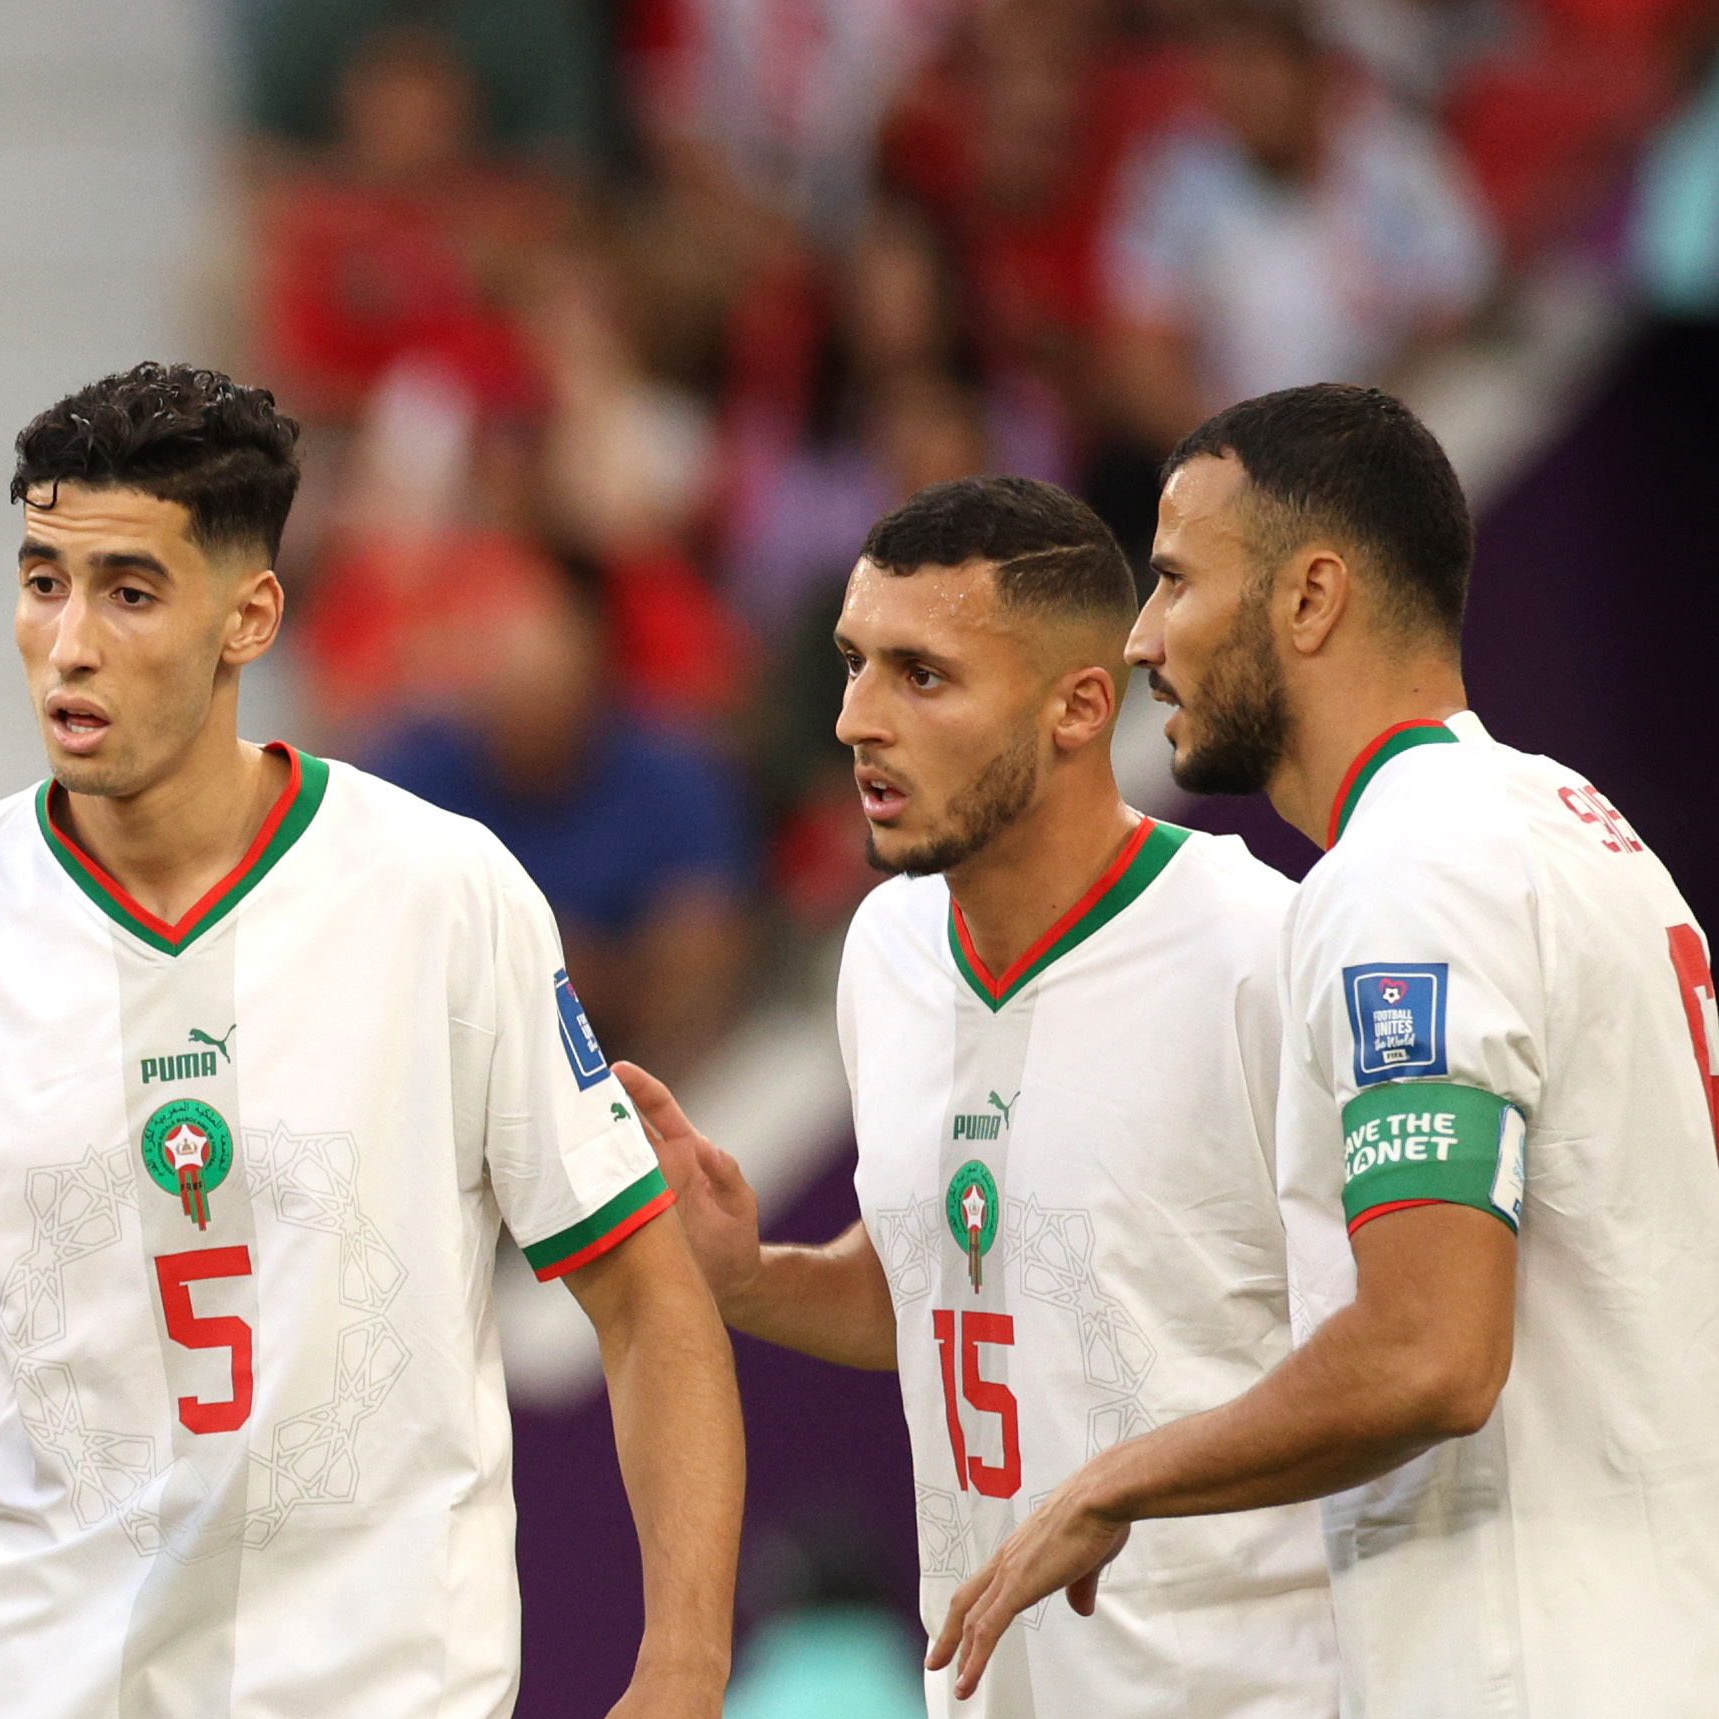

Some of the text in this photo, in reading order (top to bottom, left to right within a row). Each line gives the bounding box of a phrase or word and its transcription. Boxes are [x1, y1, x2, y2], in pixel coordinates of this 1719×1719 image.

[1373, 1009, 1413, 1021] FOOTBALL
[1374, 1020, 1414, 1037] UNITES
[1374, 1033, 1416, 1051] the World
[1385, 1051, 1402, 1060] FIFA
[141, 1052, 217, 1084] PUMA
[953, 1115, 1002, 1141] PUMA
[1342, 1112, 1456, 1155] AVE THE
[1344, 1136, 1459, 1184] LANET
[154, 1245, 254, 1435] 5
[932, 1310, 1022, 1499] 15
